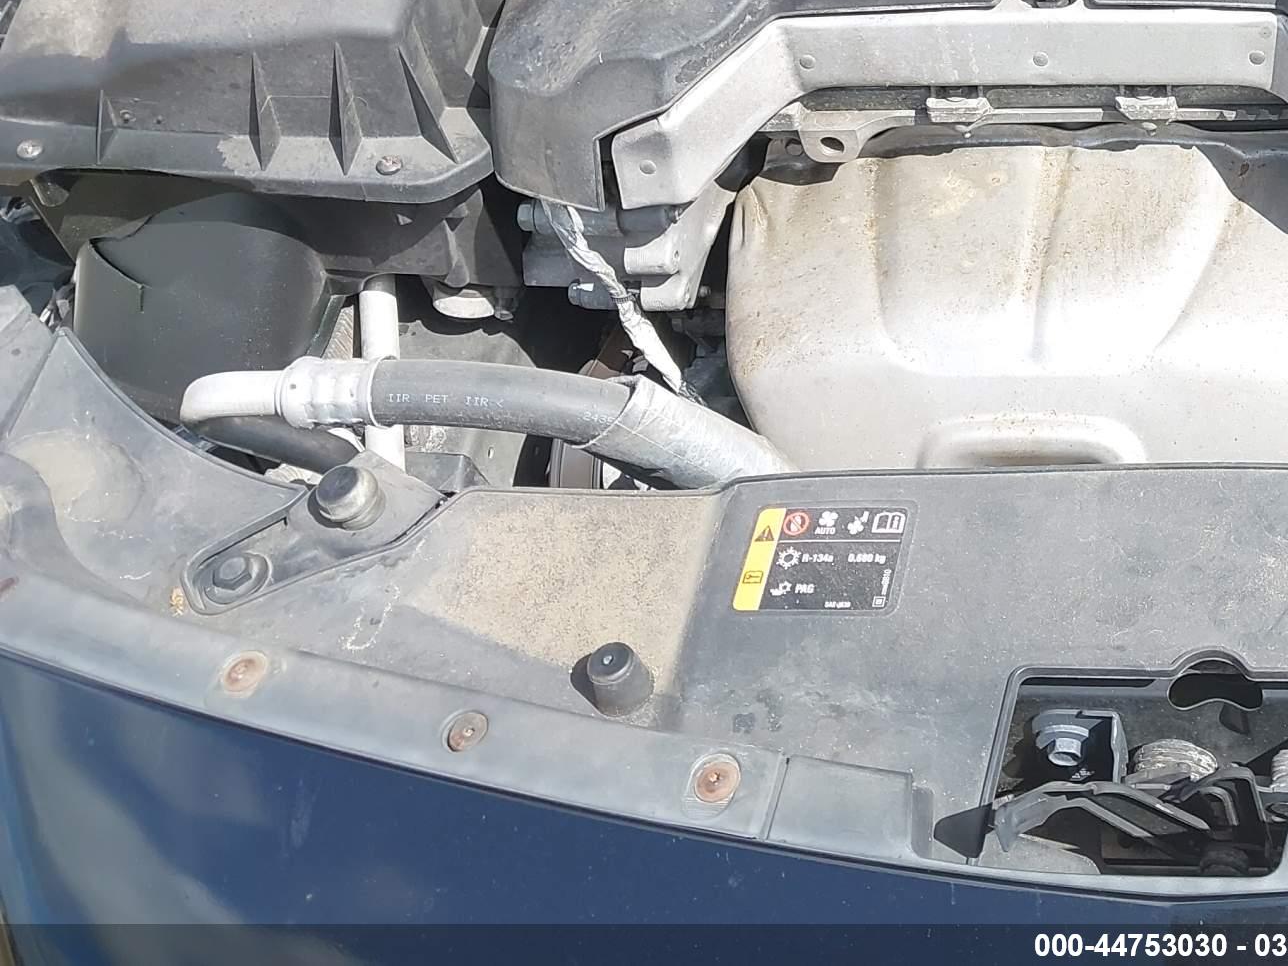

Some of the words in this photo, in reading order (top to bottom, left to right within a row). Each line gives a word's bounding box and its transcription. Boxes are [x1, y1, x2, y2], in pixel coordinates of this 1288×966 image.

[389, 393, 410, 403] IIR
[425, 394, 449, 404] PET
[814, 526, 836, 535] AUTO
[801, 554, 835, 563] R-134a
[874, 554, 887, 565] kg
[794, 584, 815, 594] PAG
